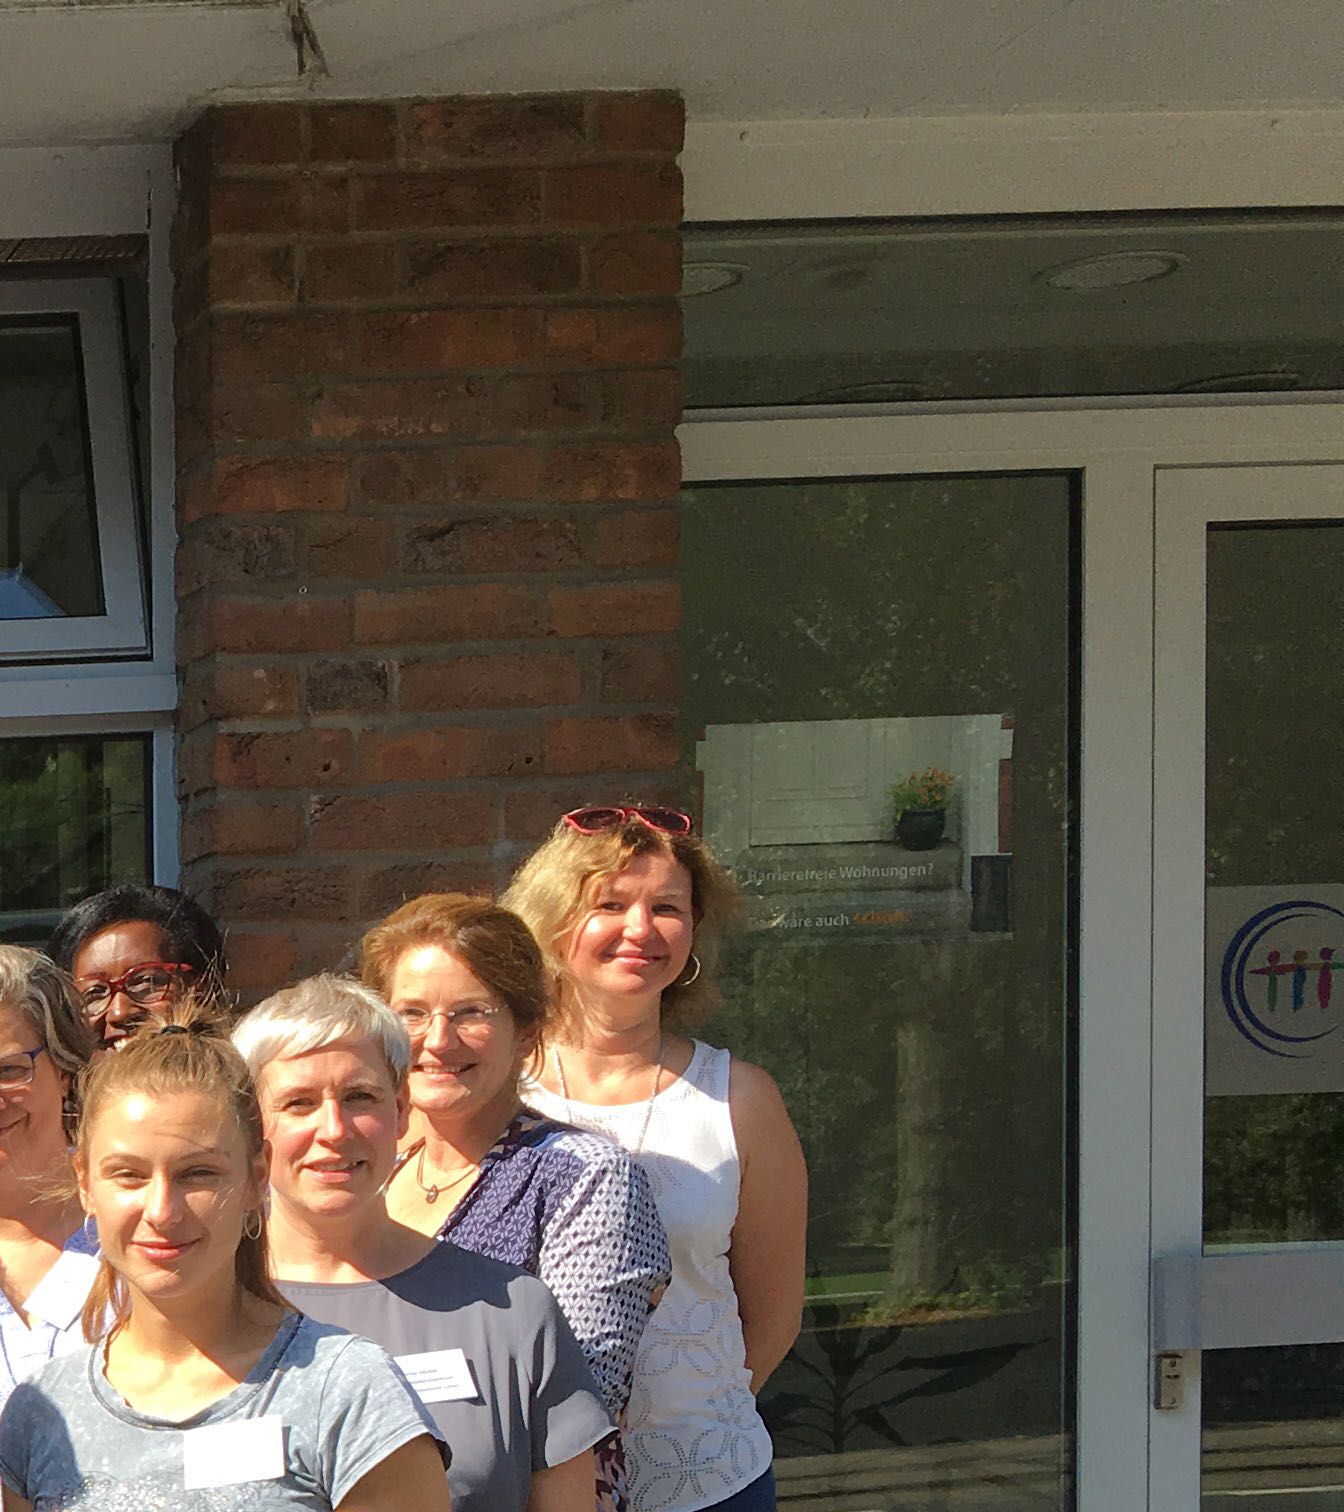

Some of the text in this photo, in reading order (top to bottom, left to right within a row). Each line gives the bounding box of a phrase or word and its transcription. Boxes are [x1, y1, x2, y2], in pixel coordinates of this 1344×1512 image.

[749, 862, 934, 881] Barrierefreie Wohnungen?
[815, 913, 850, 927] auch
